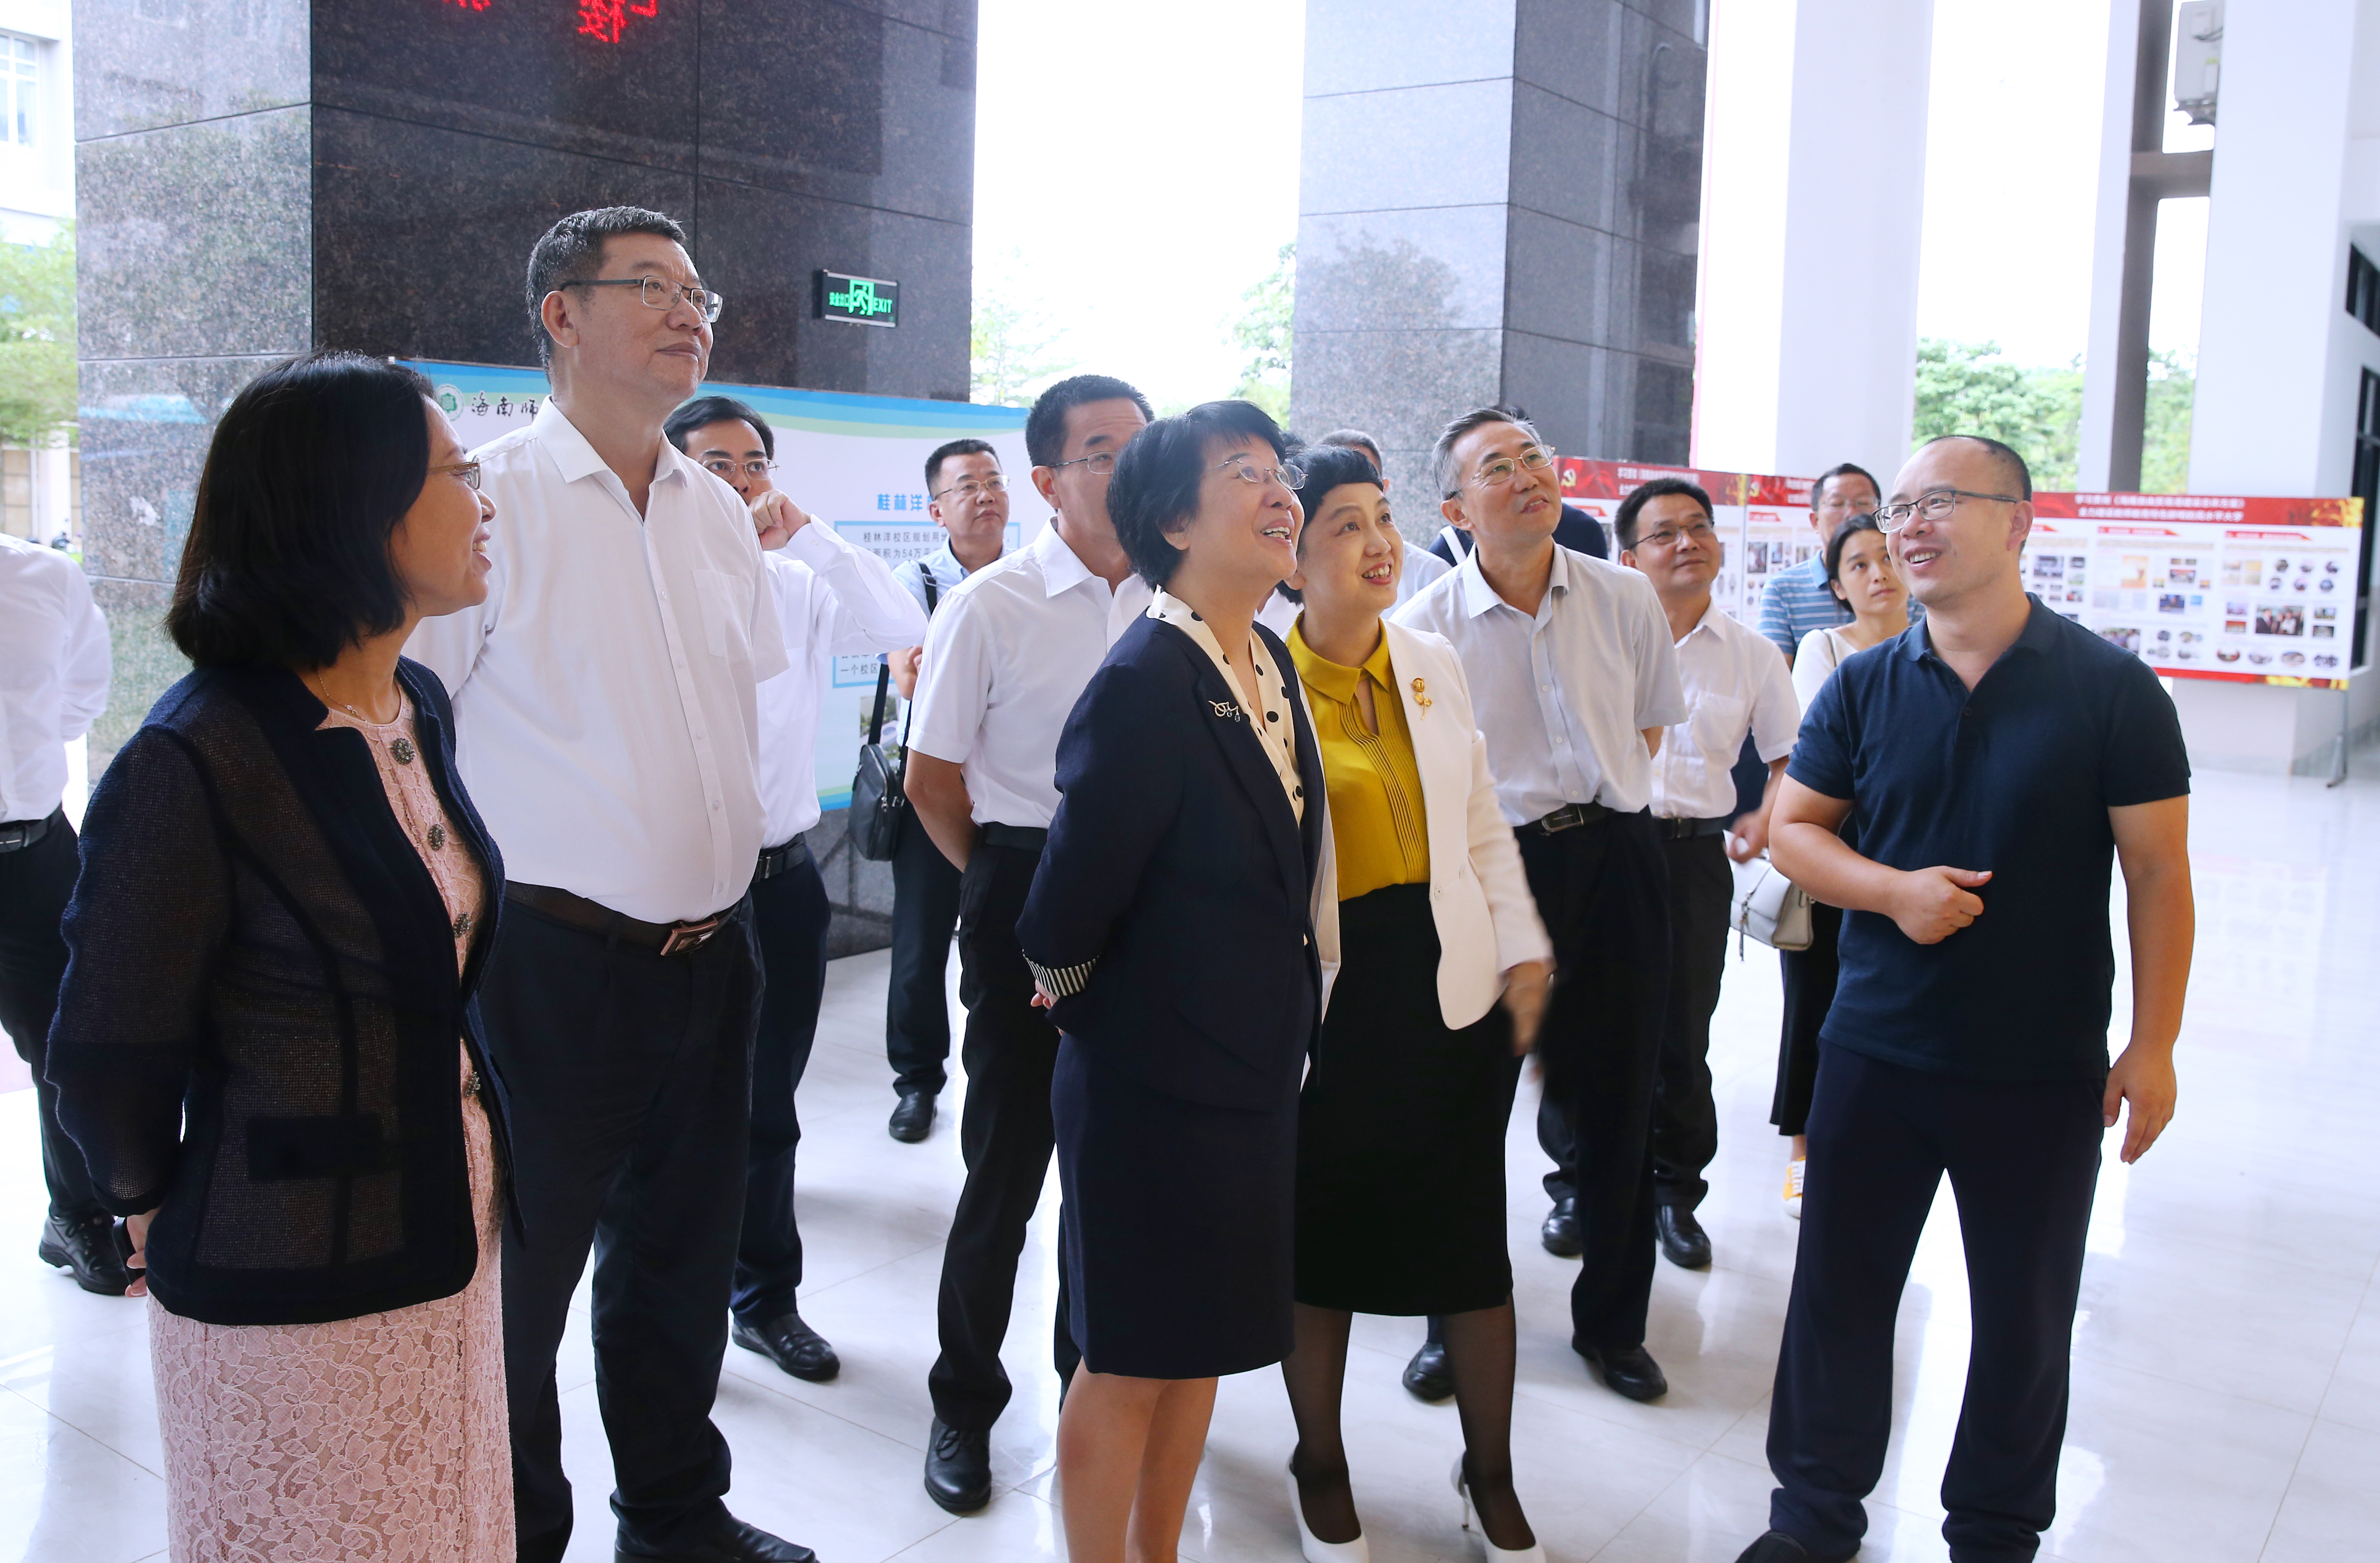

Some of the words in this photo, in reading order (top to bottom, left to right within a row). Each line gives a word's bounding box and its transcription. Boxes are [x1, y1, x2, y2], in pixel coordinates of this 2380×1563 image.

[873, 297, 893, 313] EXIT
[840, 663, 878, 675] 一个校区
